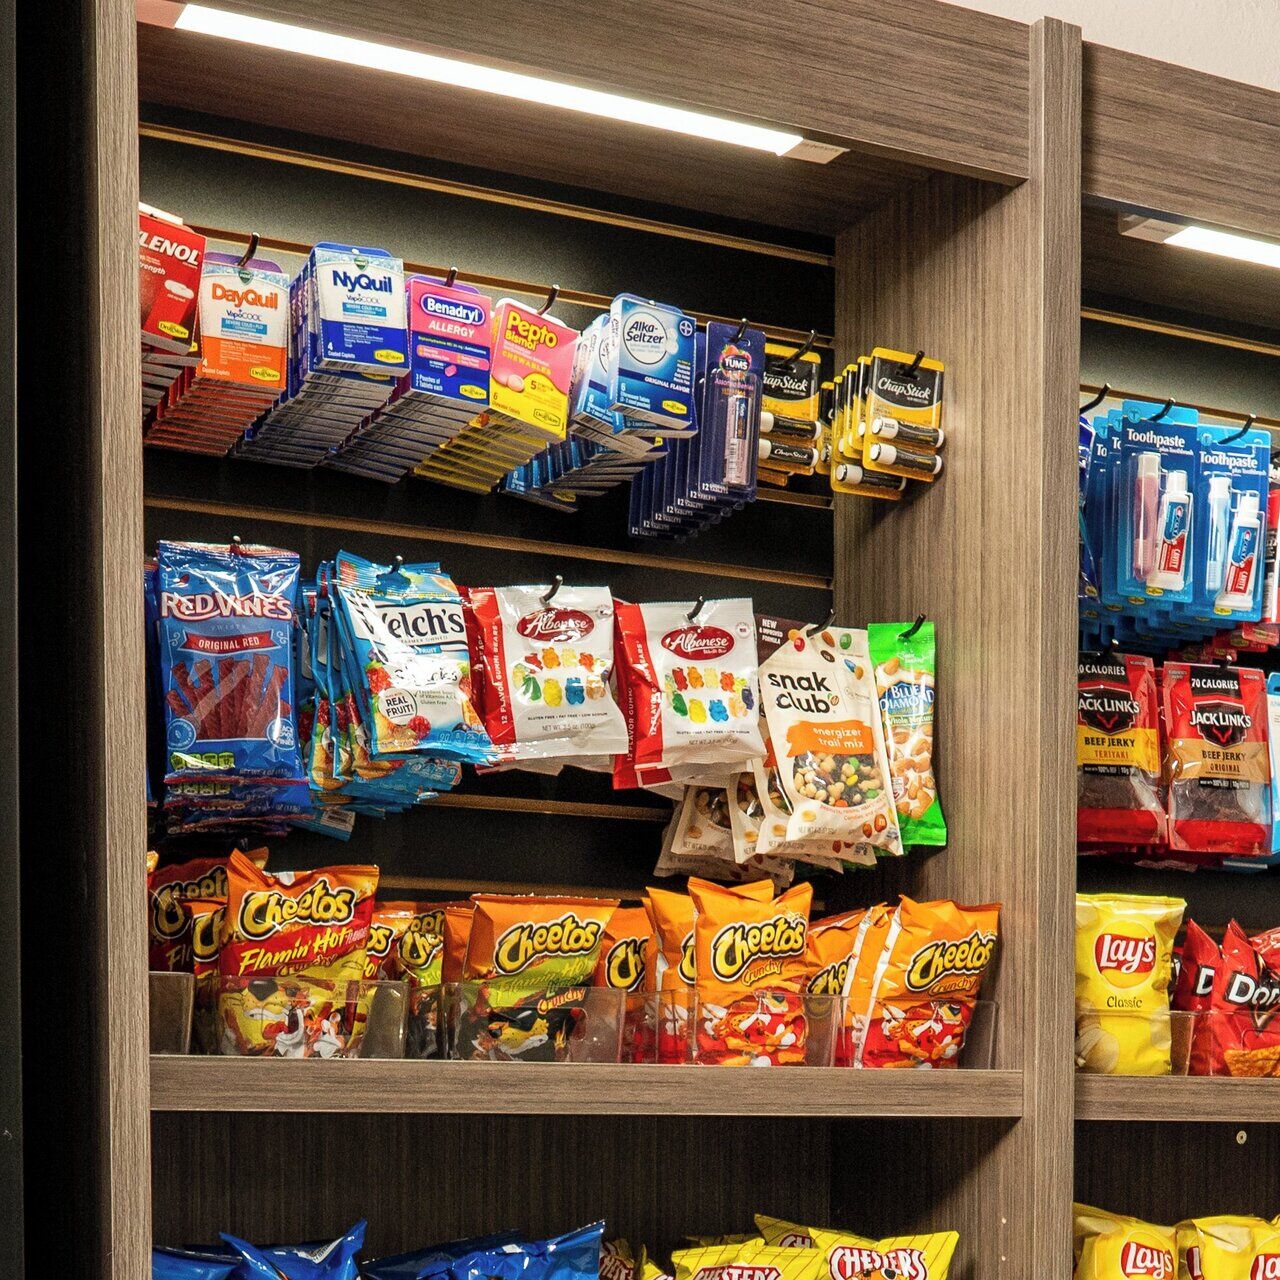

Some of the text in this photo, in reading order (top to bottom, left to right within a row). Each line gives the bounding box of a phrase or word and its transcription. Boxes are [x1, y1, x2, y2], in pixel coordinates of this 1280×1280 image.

[333, 270, 392, 295] NyQuil
[212, 283, 279, 309] DayQuil
[426, 298, 480, 323] Benadryl
[428, 320, 474, 337] ALLERGY
[507, 310, 558, 349] Pepto
[631, 319, 657, 334] Alka-
[505, 329, 537, 352] Bismol
[625, 331, 665, 345] Seltzer
[724, 357, 749, 372] TUMS
[644, 376, 691, 394] ORIGINAL FLAVOR
[877, 378, 931, 400] ChapStick
[1126, 428, 1185, 448] Toothpaste
[1199, 450, 1258, 468] Toothpaste
[197, 636, 260, 650] ORIGINAL RED
[665, 632, 729, 651] Albanese
[1087, 665, 1125, 676] CALORIES
[768, 672, 831, 692] snak
[1191, 678, 1239, 690] 70 CALORIES
[385, 697, 409, 708] REAL
[386, 704, 415, 716] FRUIT!
[775, 691, 831, 714] club
[1189, 710, 1252, 727] JACK LINK'S
[812, 726, 862, 739] energizer
[818, 736, 865, 749] trail mix
[1084, 737, 1135, 748] BEEF JERKY
[1202, 750, 1246, 761] BEEF JERKY
[1210, 763, 1240, 773] ORIGINAL
[238, 878, 357, 939] Cheetos
[494, 910, 603, 976] Cheetos
[711, 914, 806, 982] Cheetos
[905, 932, 994, 992] Cheetos
[1099, 933, 1156, 974] Lay's
[742, 960, 783, 987] Crunchy
[1106, 996, 1142, 1008] Classic
[1125, 1242, 1173, 1279] Lay's
